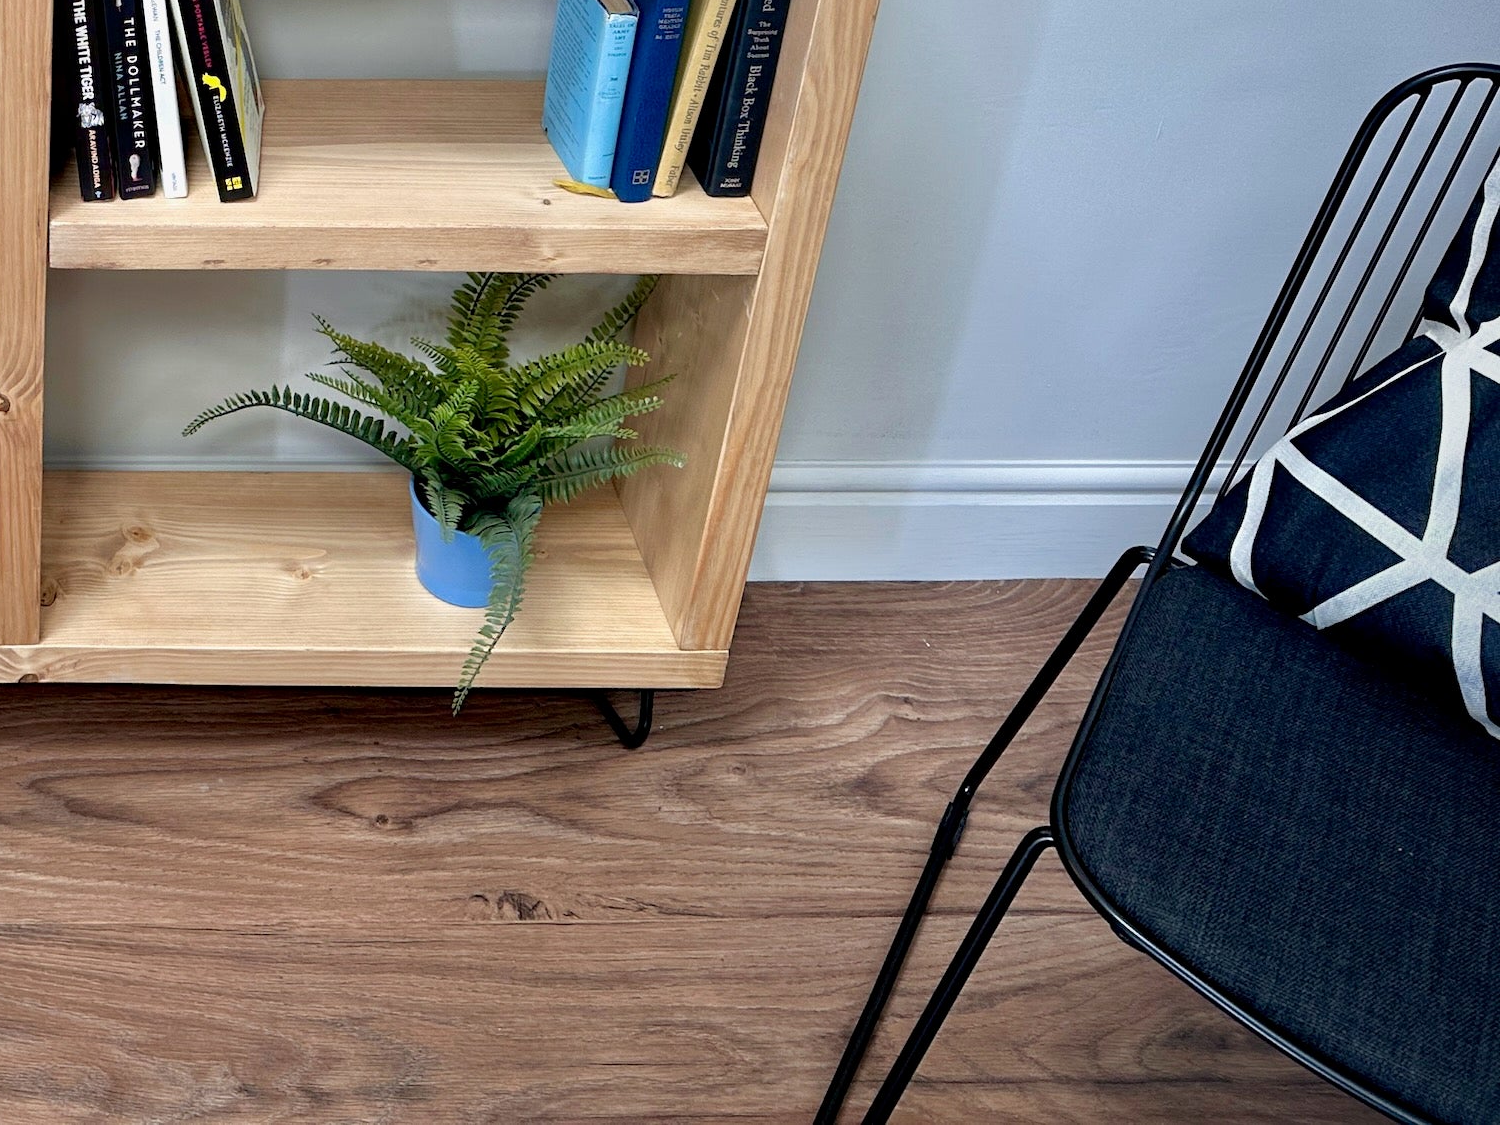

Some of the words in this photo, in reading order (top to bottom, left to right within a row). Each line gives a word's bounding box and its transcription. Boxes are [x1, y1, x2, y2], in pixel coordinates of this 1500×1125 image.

[75, 25, 92, 65] WHITE
[124, 17, 137, 48] THE
[707, 30, 719, 44] of
[114, 52, 124, 81] NINA
[702, 42, 717, 61] Tim
[79, 65, 95, 101] TIGER
[695, 62, 710, 95] Rabbit
[744, 65, 762, 95] Black
[117, 85, 128, 121] ALLAN
[127, 55, 145, 149] DOLLMAKER
[739, 97, 755, 119] Box
[727, 120, 750, 169] Thinking
